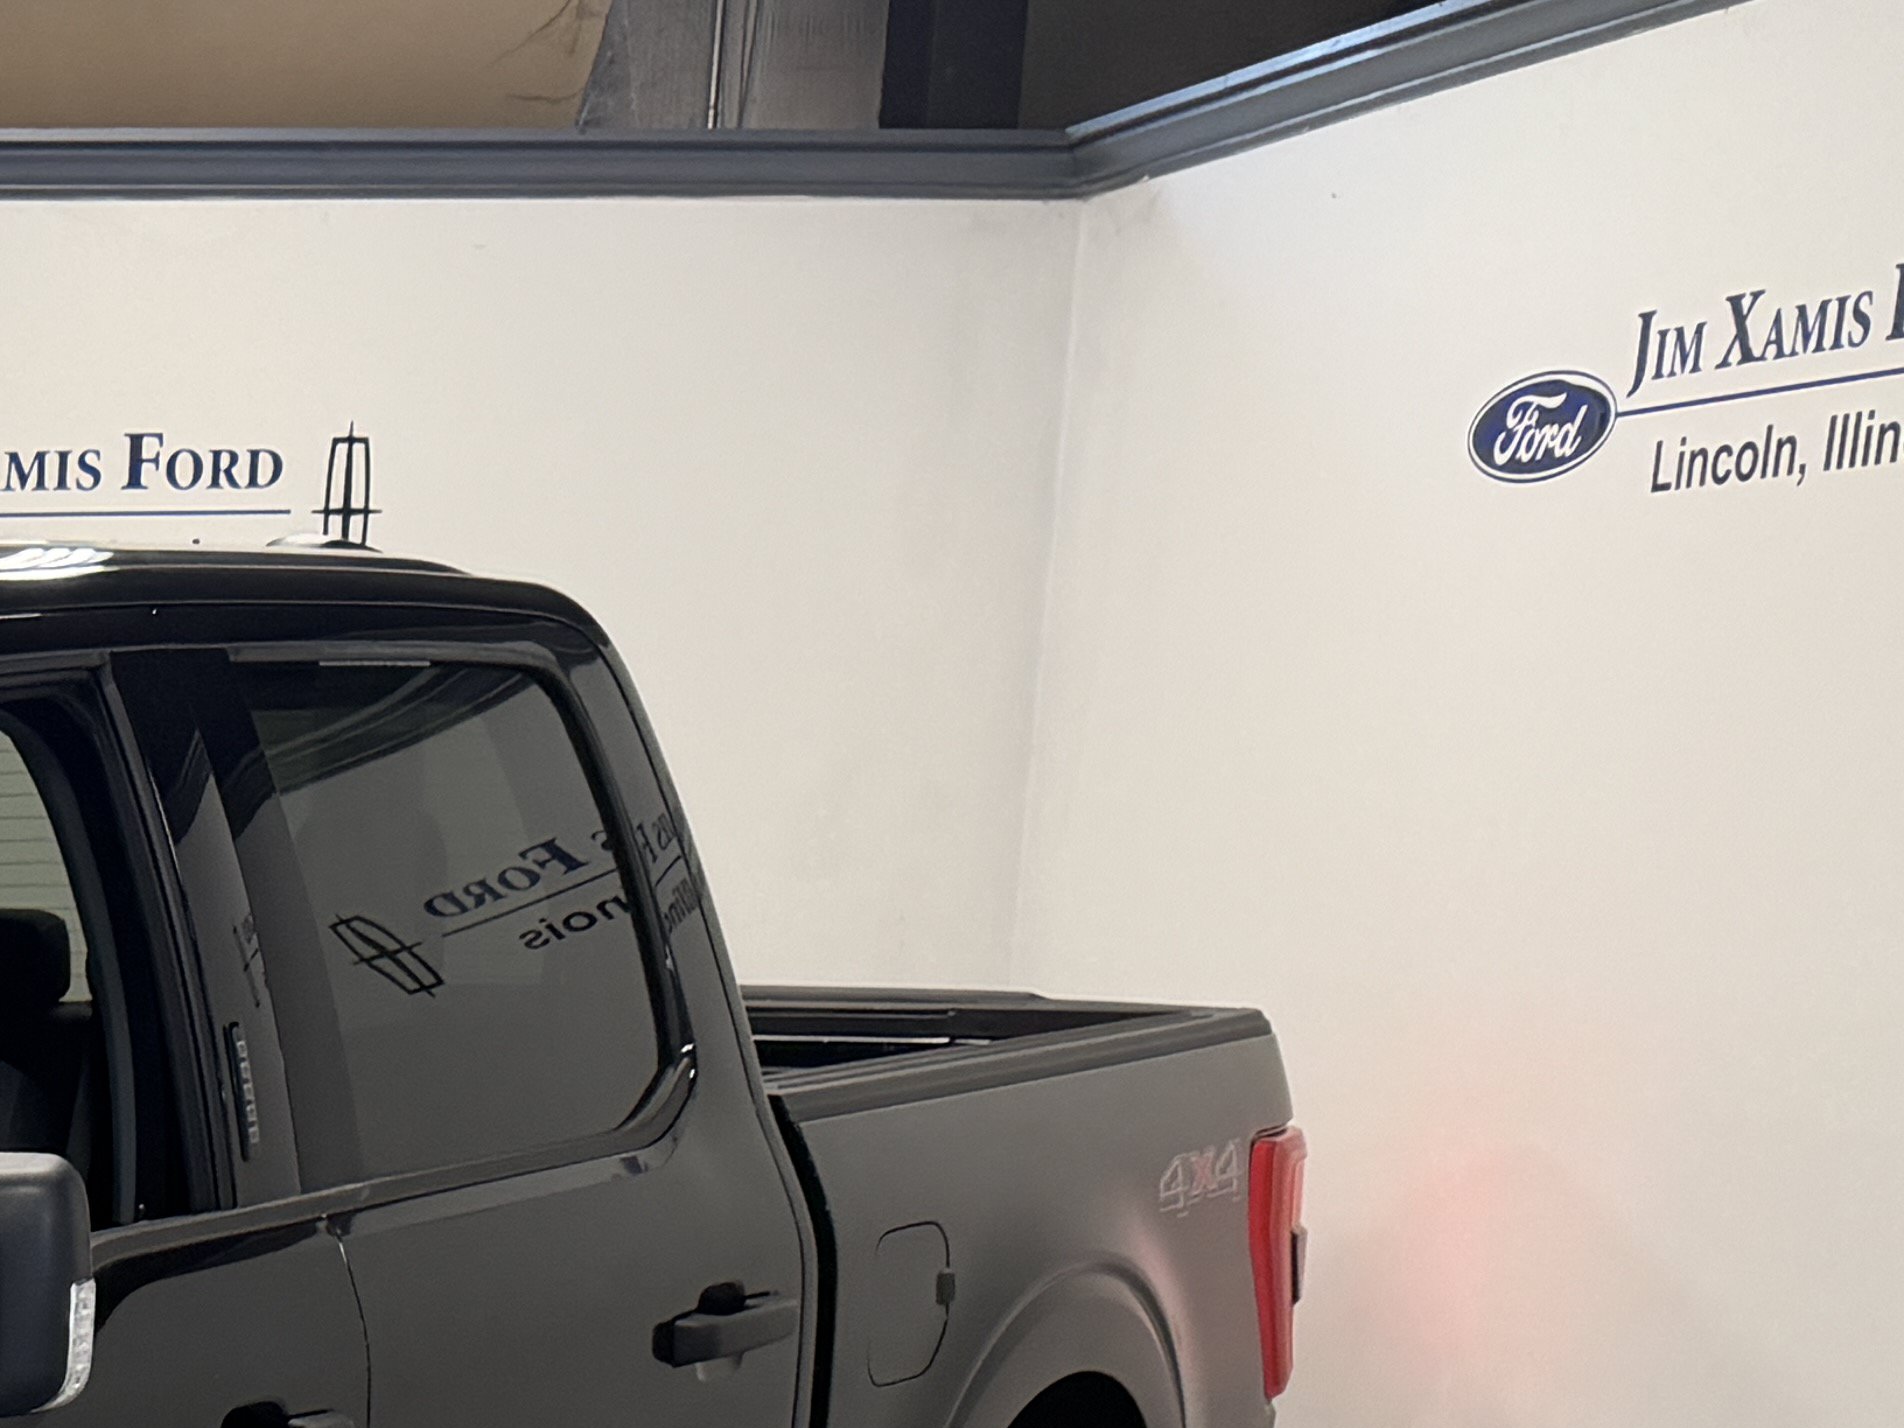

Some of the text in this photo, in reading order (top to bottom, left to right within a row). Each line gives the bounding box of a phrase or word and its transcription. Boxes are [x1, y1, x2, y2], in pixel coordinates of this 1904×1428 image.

[1626, 309, 1708, 399] JIM
[1715, 288, 1873, 371] XAMIS
[122, 431, 284, 492] FORD
[1493, 391, 1588, 467] Ford
[1650, 410, 1904, 494] Lincoln, Illin
